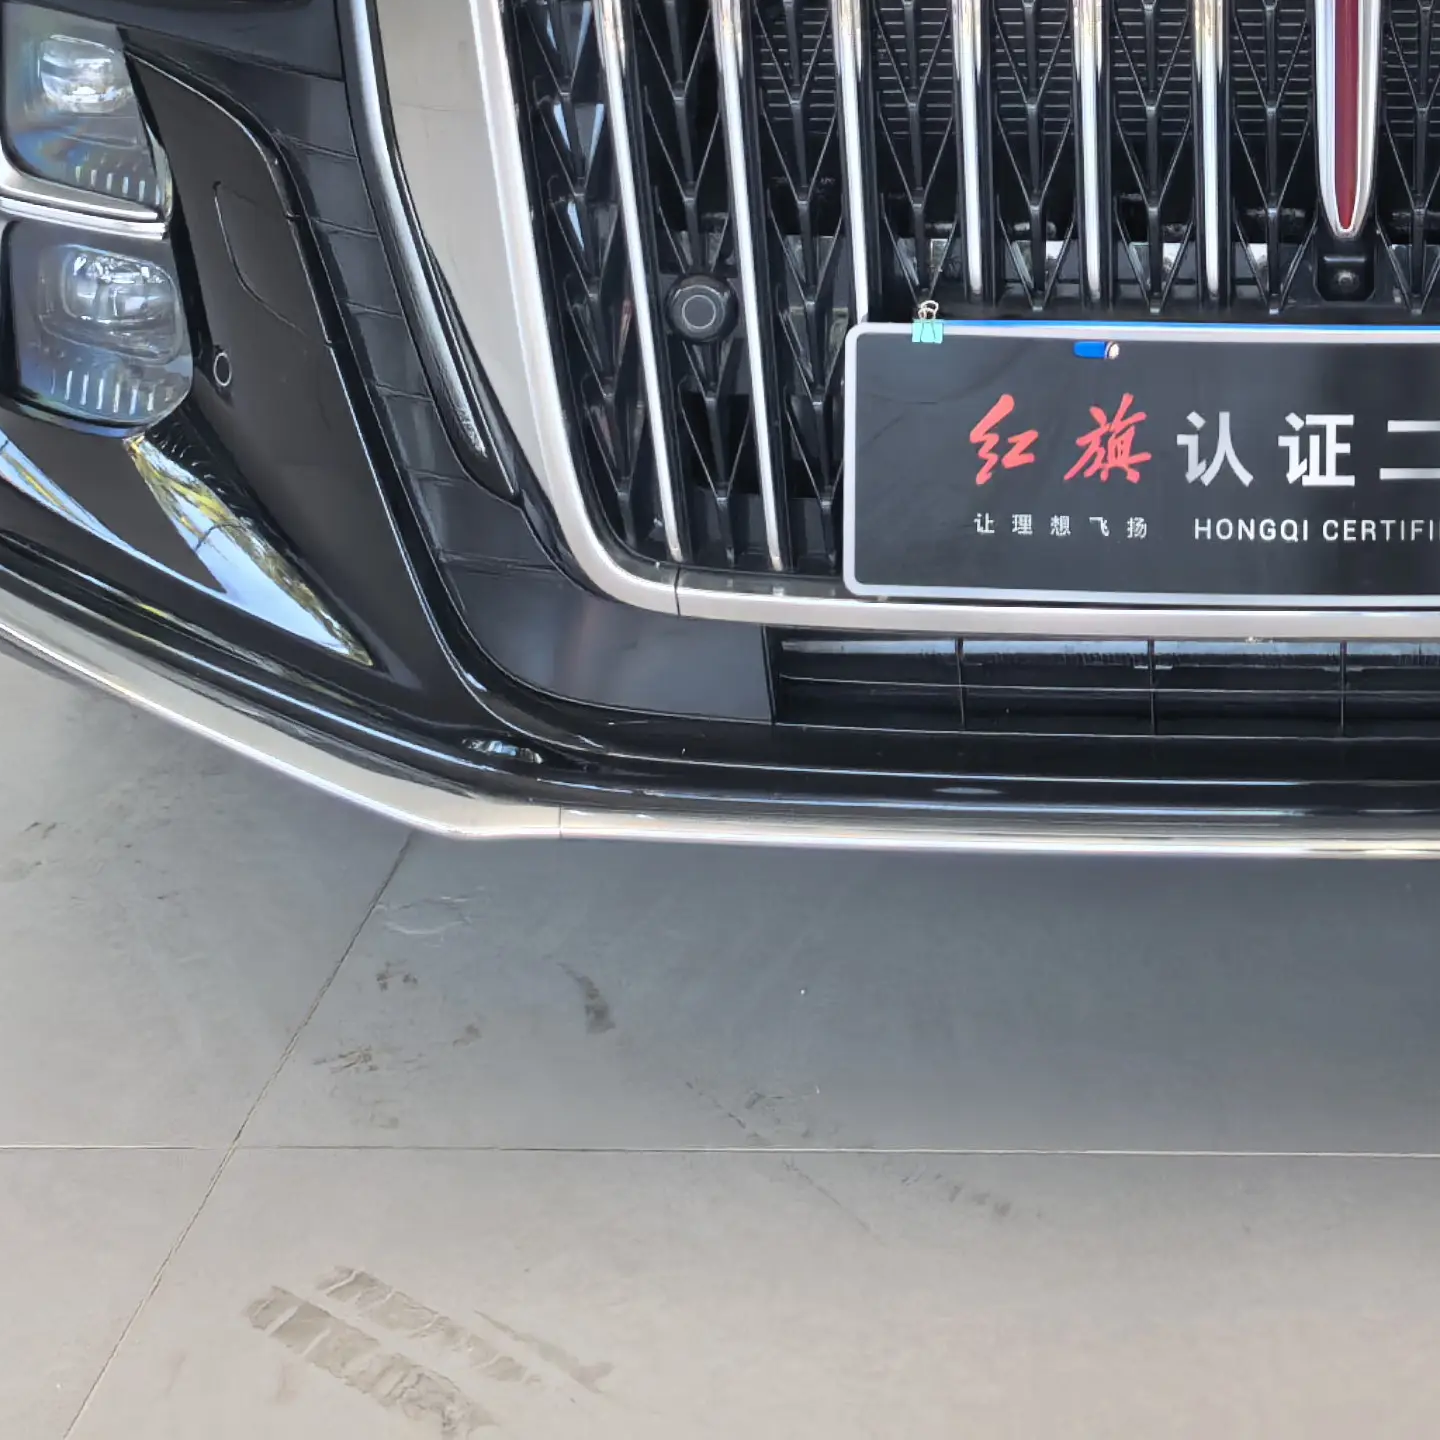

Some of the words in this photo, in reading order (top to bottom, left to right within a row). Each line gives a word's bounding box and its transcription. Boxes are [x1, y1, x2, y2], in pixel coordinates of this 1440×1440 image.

[974, 513, 1146, 538] 让理想飞扬
[1195, 519, 1308, 542] HONGQI
